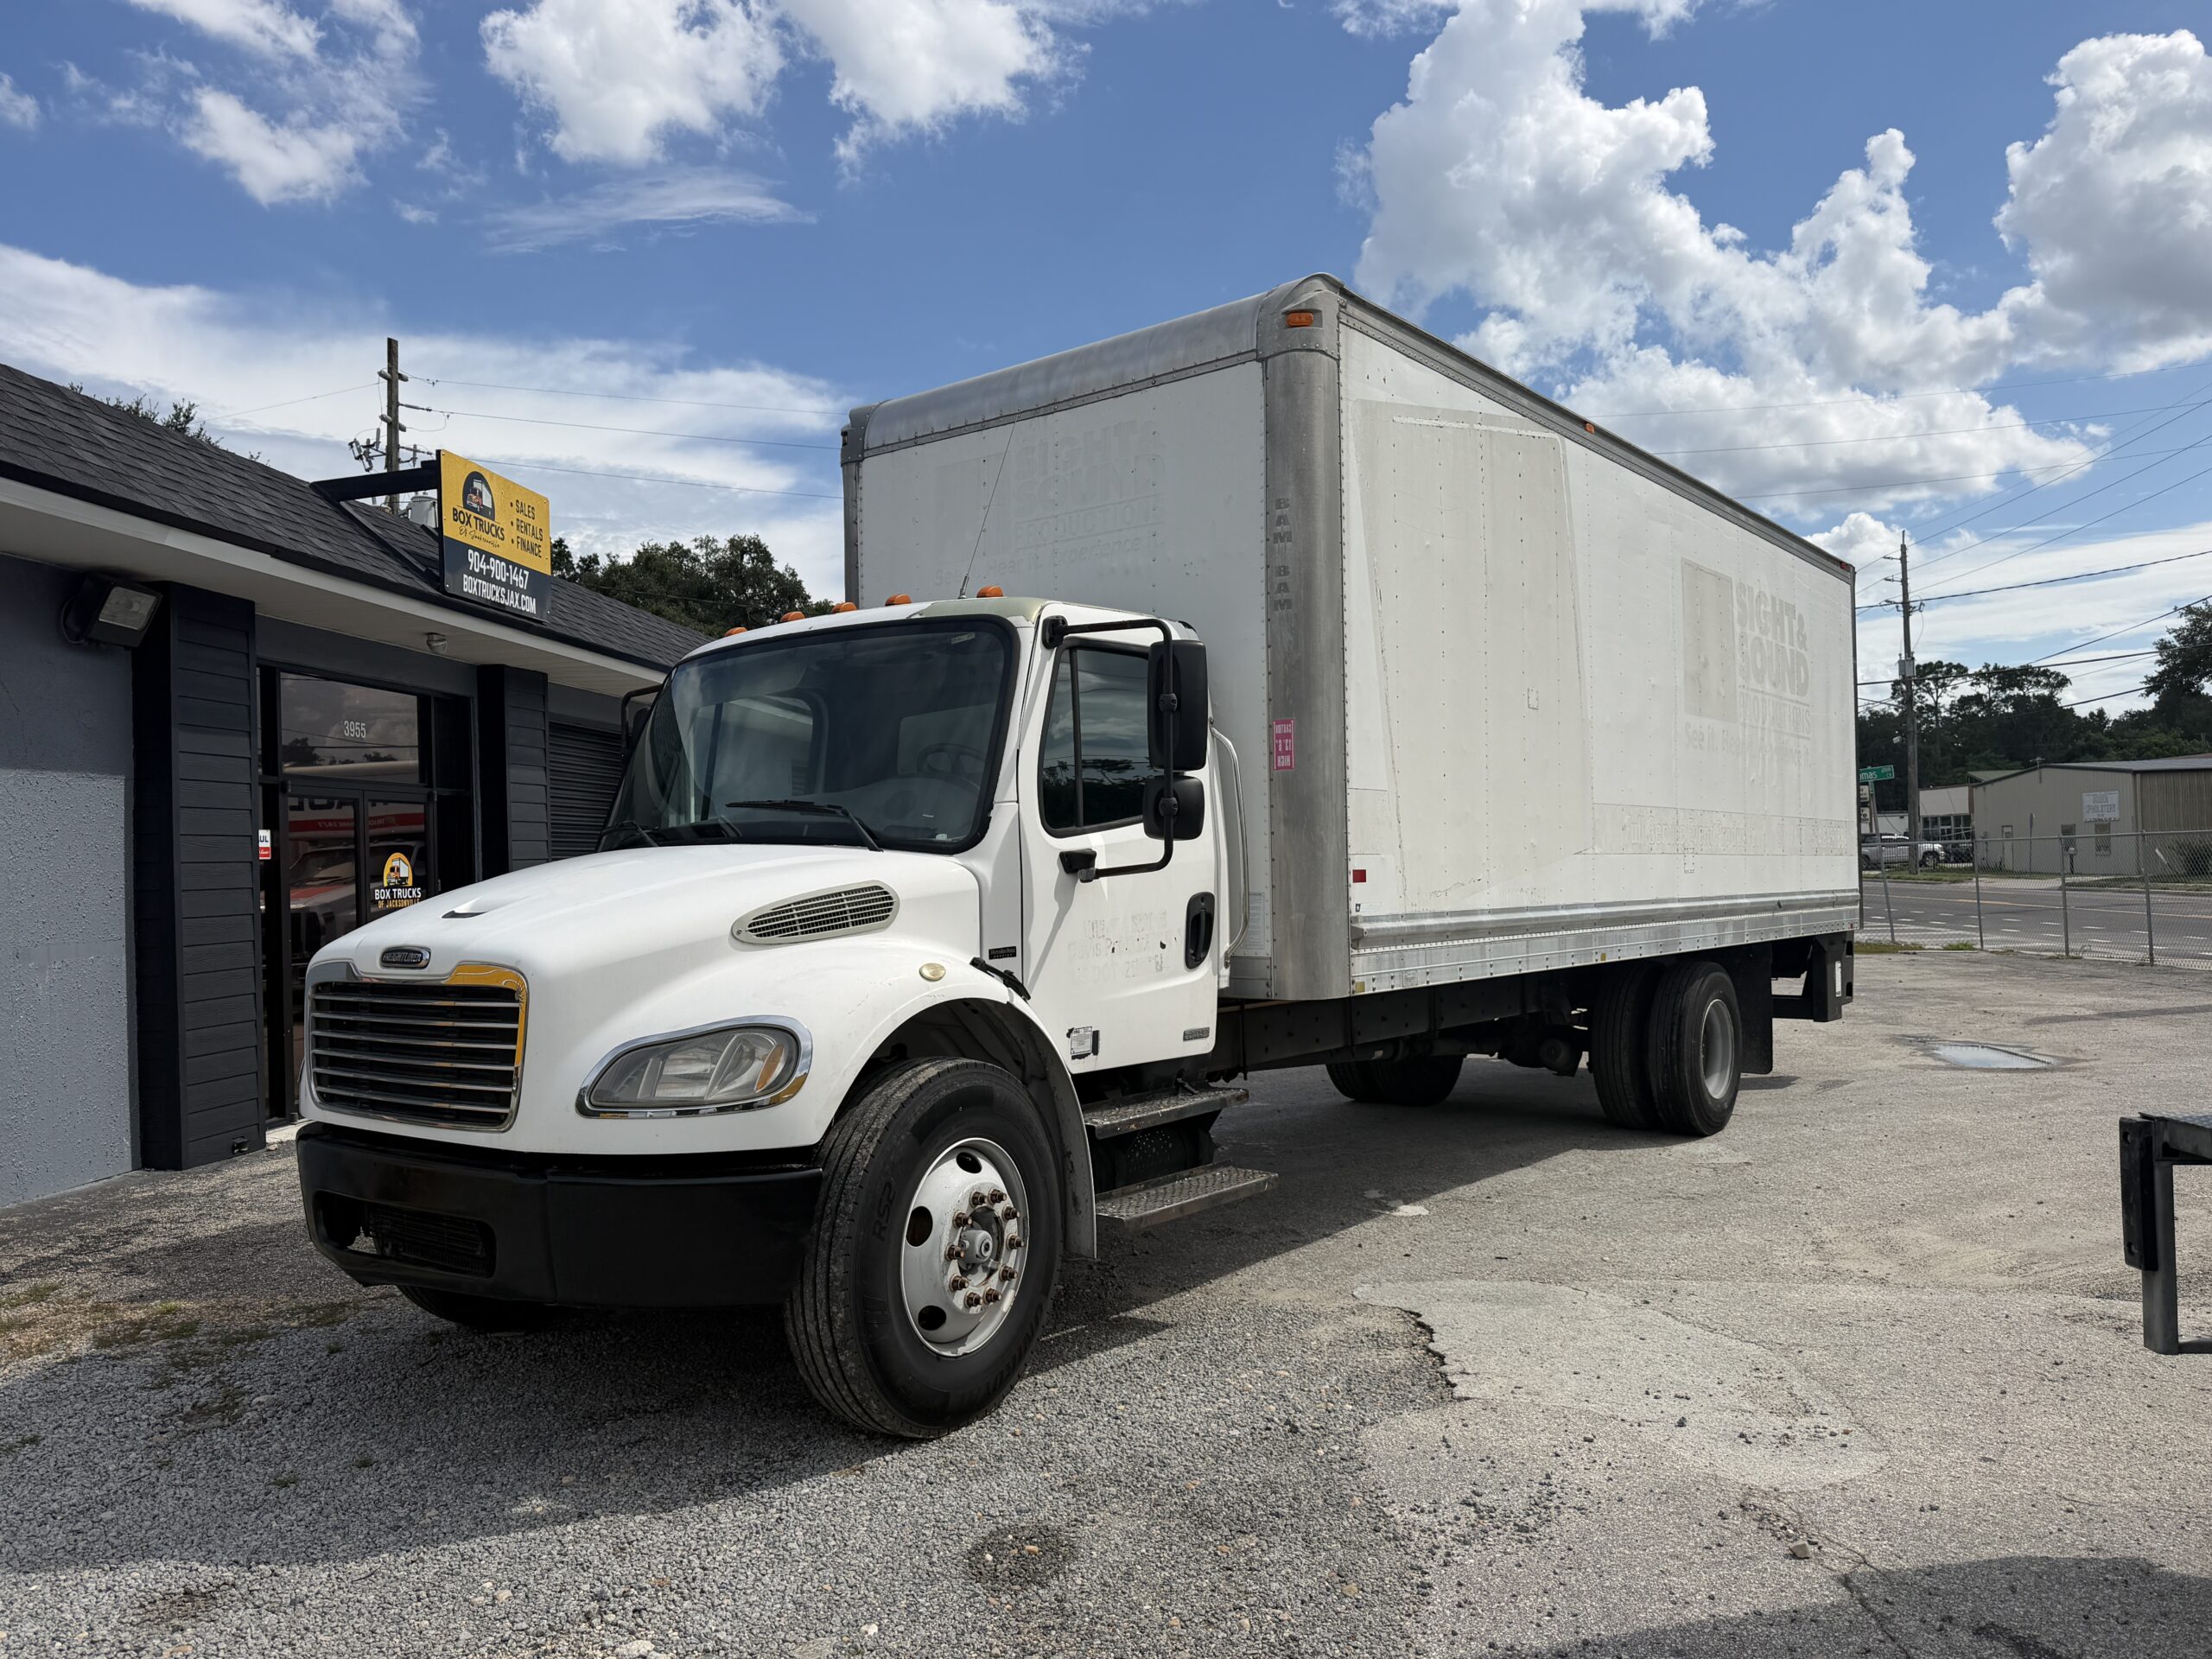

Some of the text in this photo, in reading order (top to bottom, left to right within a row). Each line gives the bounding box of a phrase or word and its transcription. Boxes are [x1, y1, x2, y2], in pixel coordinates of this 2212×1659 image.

[516, 499, 536, 520] SALES
[452, 507, 505, 542] BOX TRUCKS
[516, 518, 543, 542] RENTALS
[517, 536, 542, 558] FINANCE
[467, 549, 530, 590] 904-900-1467
[463, 574, 537, 614] BOXTRUCKSJAX.COM
[1736, 581, 1808, 652] SIGHT &
[1738, 631, 1809, 698] SOUND
[344, 720, 366, 739] 3955
[258, 835, 269, 843] UL
[374, 887, 422, 900] BOX TRUCKS
[378, 899, 385, 909] OF
[382, 950, 422, 963] FREIGHTLINER
